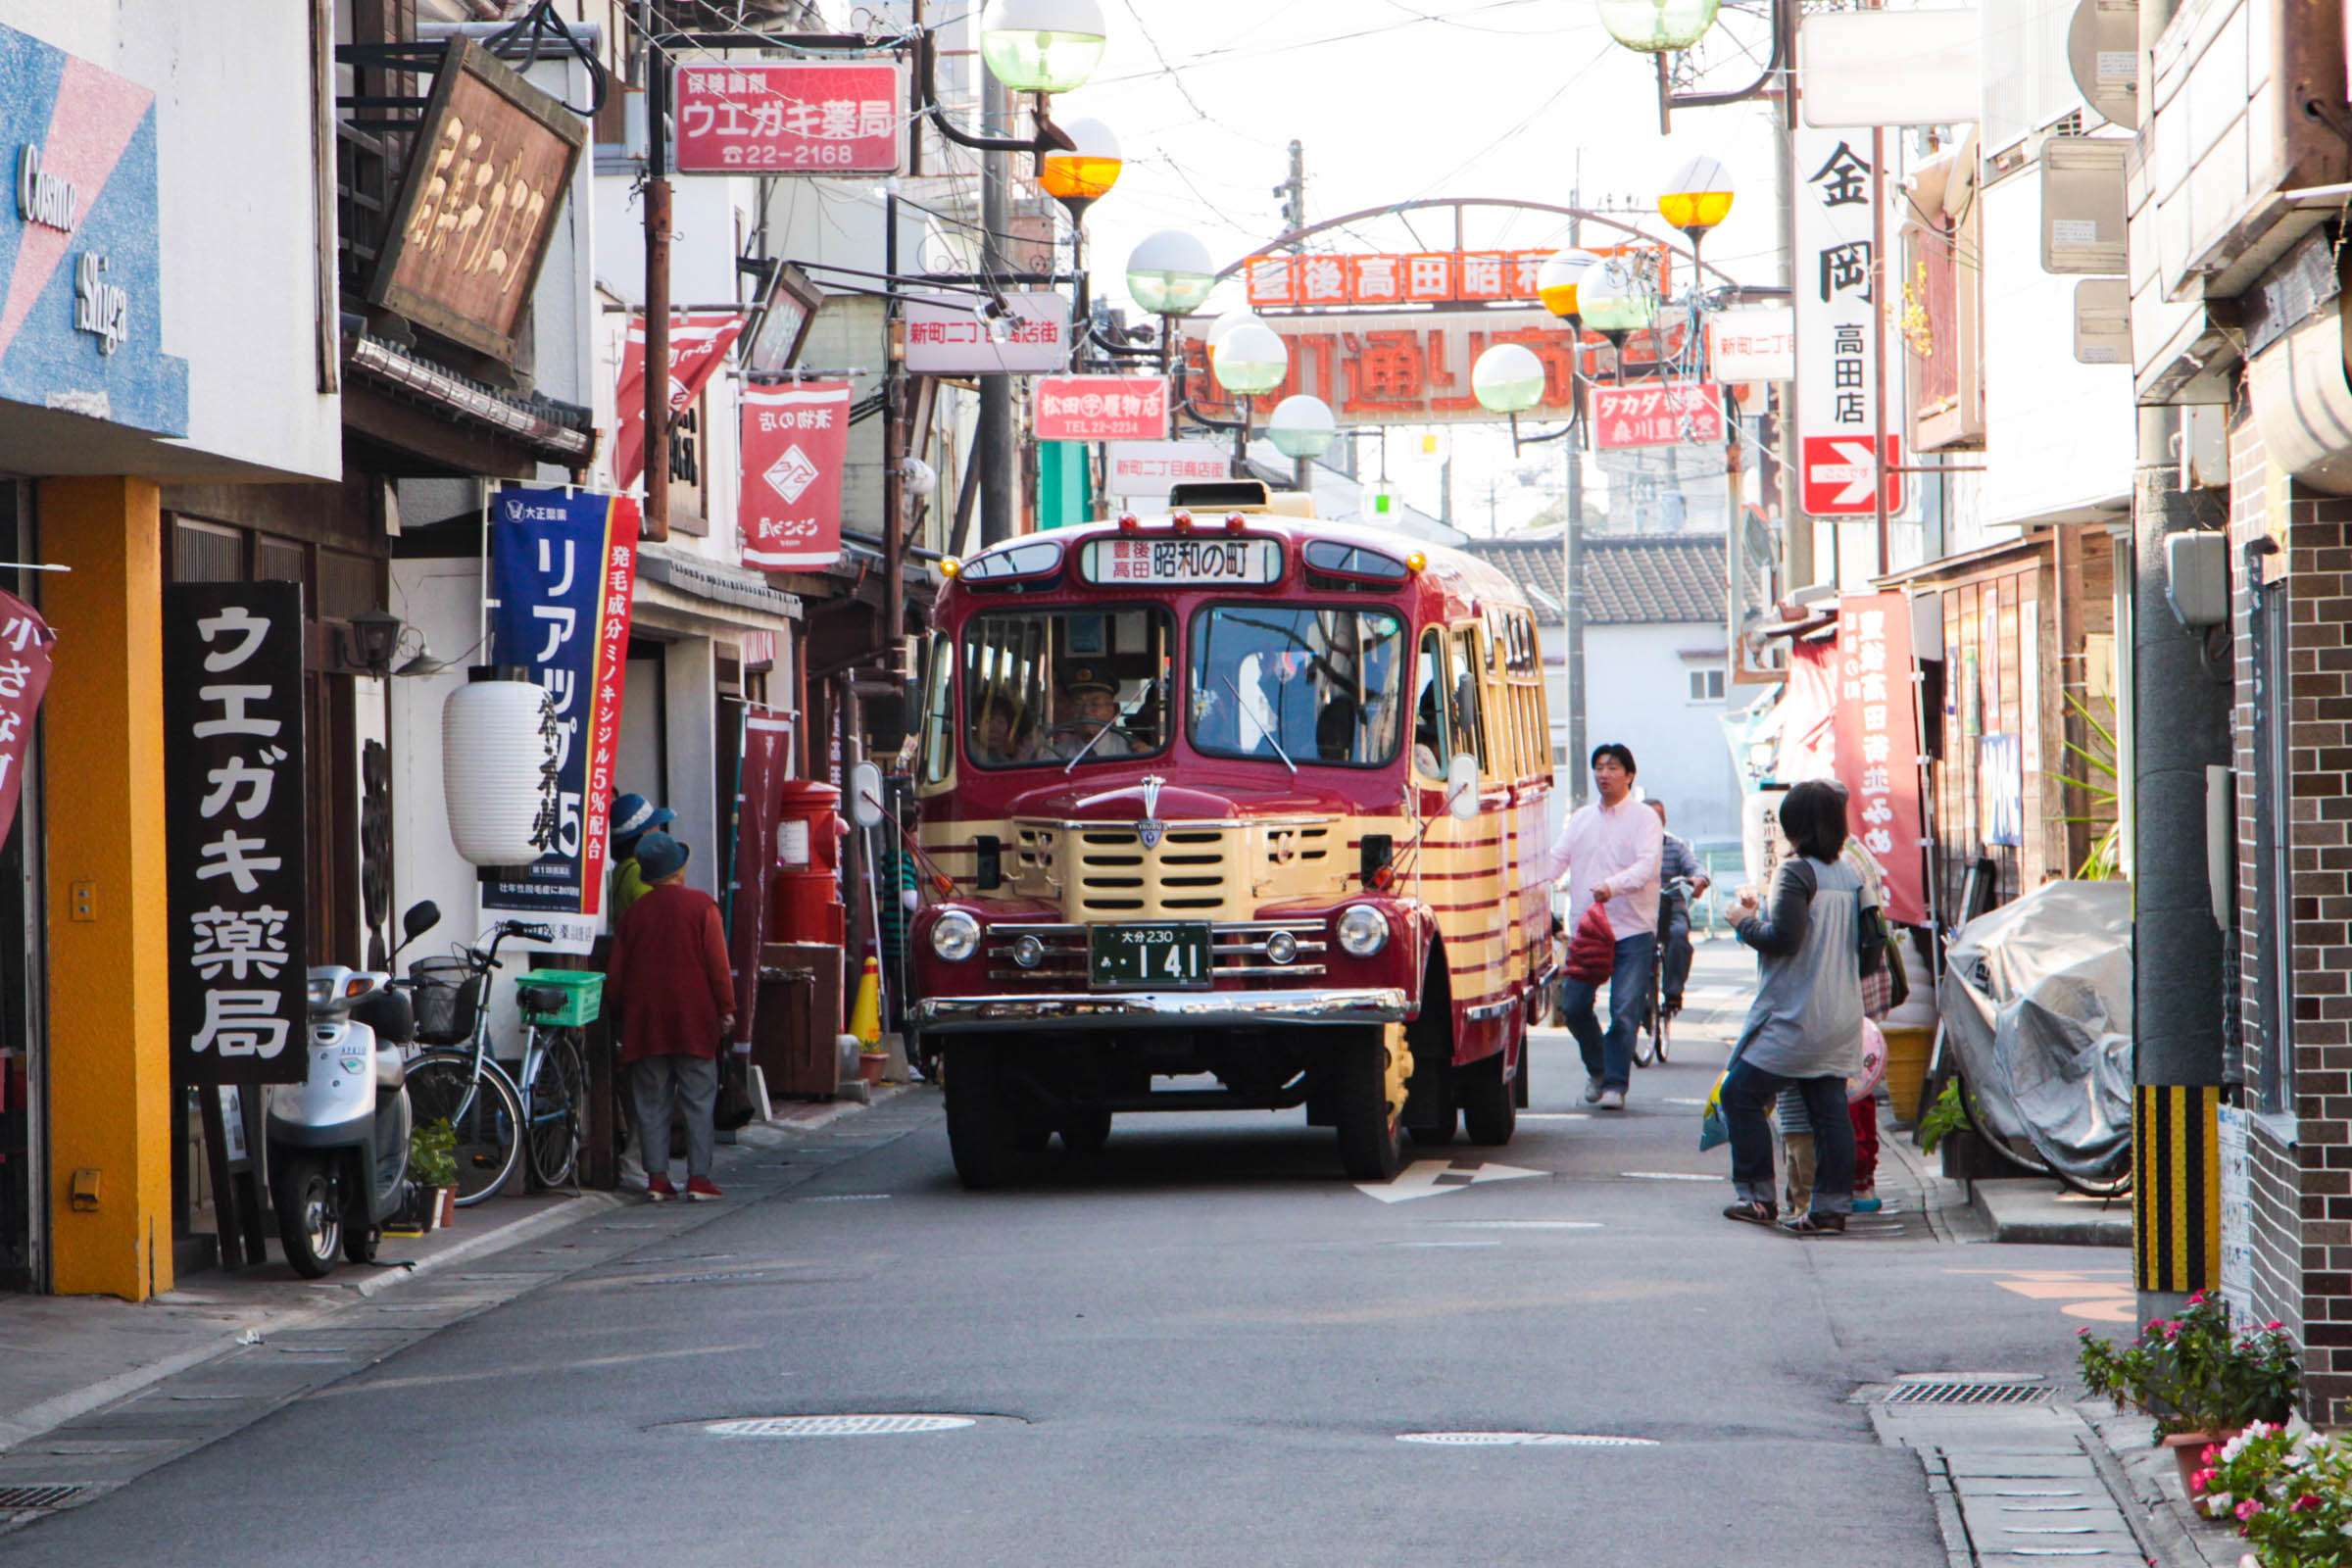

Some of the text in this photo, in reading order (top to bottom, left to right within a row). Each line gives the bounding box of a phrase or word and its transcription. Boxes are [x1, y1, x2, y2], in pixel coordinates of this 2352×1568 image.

[688, 73, 766, 94] 保険調剤
[683, 99, 894, 139] ウエガキ薬局
[746, 145, 852, 164] 22-2168
[17, 142, 76, 233] Cosme
[1808, 141, 1878, 307] 金岡
[74, 251, 126, 356] Shiga
[1834, 323, 1864, 423] 高田店
[1113, 541, 1151, 559] 豊後
[1113, 562, 1150, 578] 高田
[1153, 542, 1249, 578] 昭和の町
[587, 545, 630, 859] 発毛成分ミノキシジル5%配合
[190, 606, 291, 1060] ウエガキ薬局
